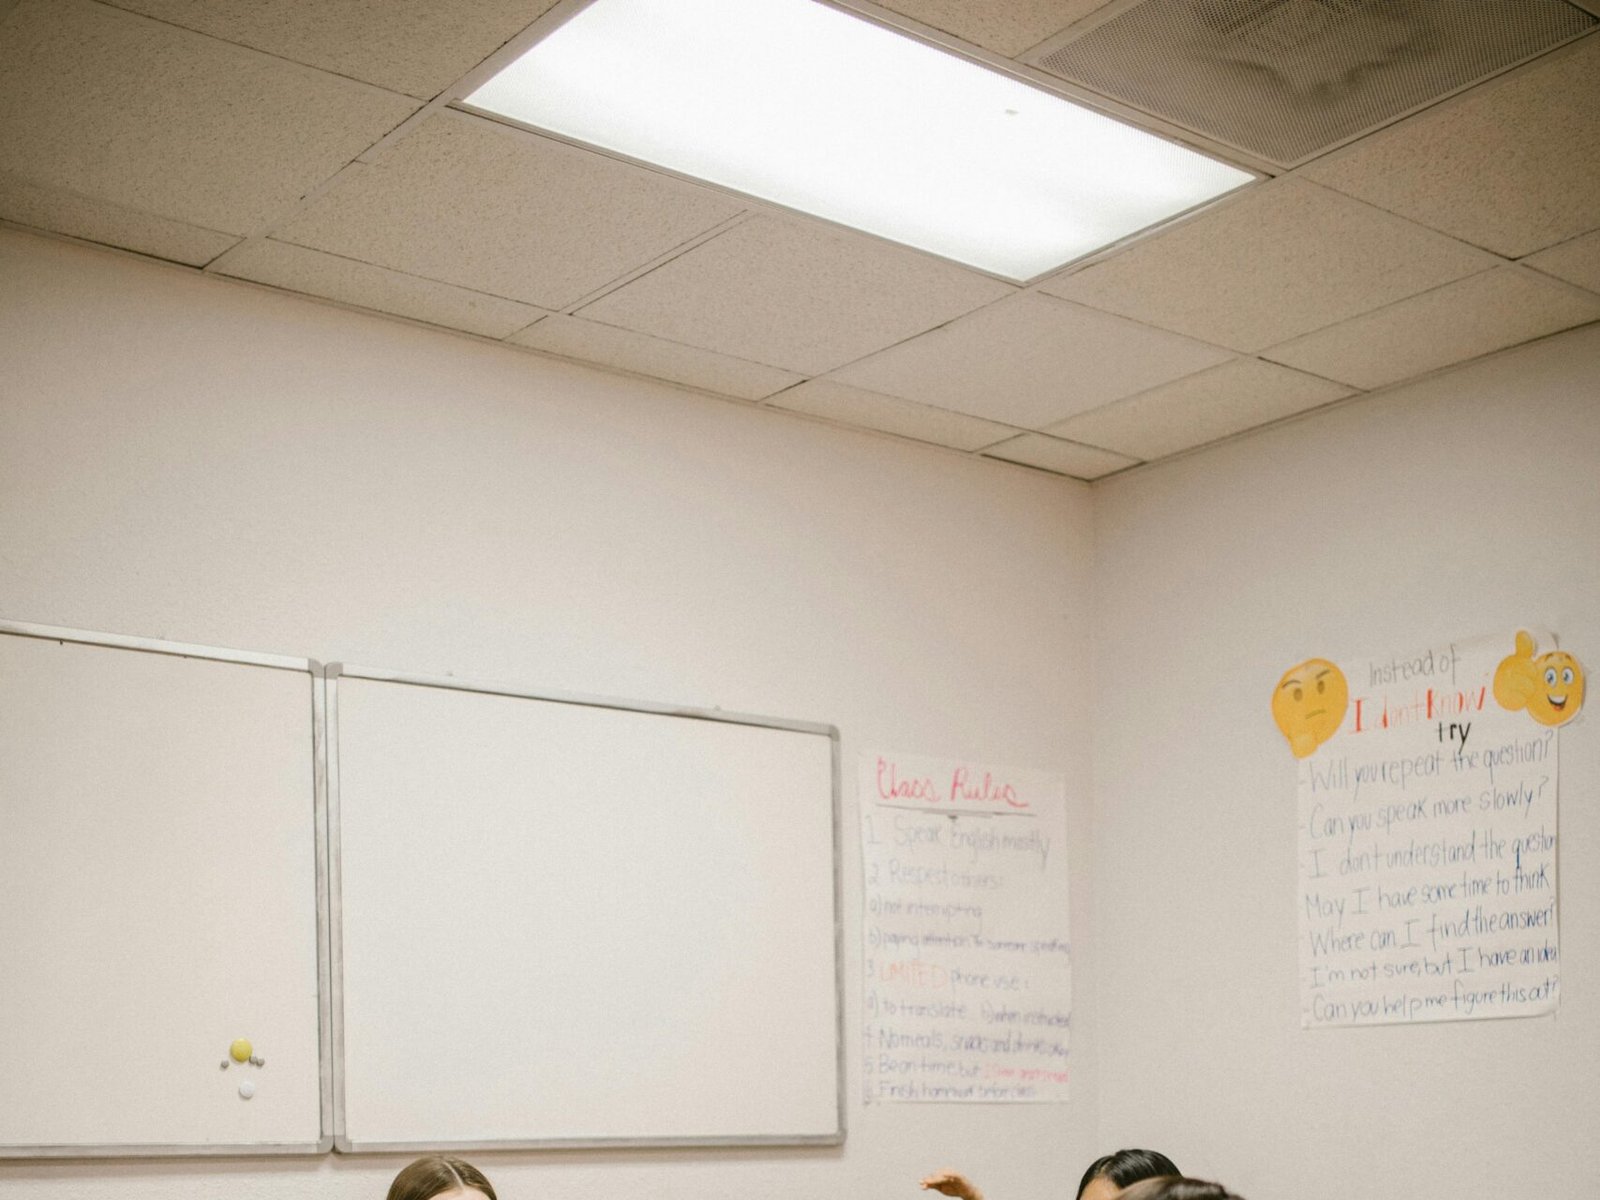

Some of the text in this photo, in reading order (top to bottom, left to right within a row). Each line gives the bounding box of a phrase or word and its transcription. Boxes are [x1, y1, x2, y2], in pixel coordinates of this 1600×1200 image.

[1370, 645, 1461, 688] Instead of
[1348, 698, 1368, 735] I
[1436, 721, 1471, 756] try
[876, 756, 1030, 808] Class Rules
[1307, 729, 1553, 803] Will you repeat the question?
[1309, 802, 1345, 840] Can
[1348, 812, 1372, 846] you
[1376, 796, 1428, 836] speak
[1433, 795, 1473, 819] more
[1308, 848, 1328, 878] I
[1386, 828, 1475, 869] understand
[1481, 827, 1506, 860] the
[1305, 862, 1551, 930] May I have some time to think
[1310, 925, 1366, 958] Where
[1370, 930, 1397, 951] can
[1400, 918, 1422, 950] I
[1427, 908, 1470, 952] find
[1472, 904, 1498, 935] the
[1310, 964, 1345, 989] I'm
[1350, 960, 1377, 982] not
[1424, 952, 1453, 976] but
[1456, 946, 1475, 974] I
[1478, 946, 1517, 969] have
[1520, 946, 1535, 966] an
[1313, 993, 1347, 1022] Can
[1350, 1000, 1380, 1024] you
[1382, 994, 1423, 1021] help
[1424, 993, 1448, 1008] me
[1450, 978, 1496, 1015] figure
[1500, 981, 1527, 1003] this
